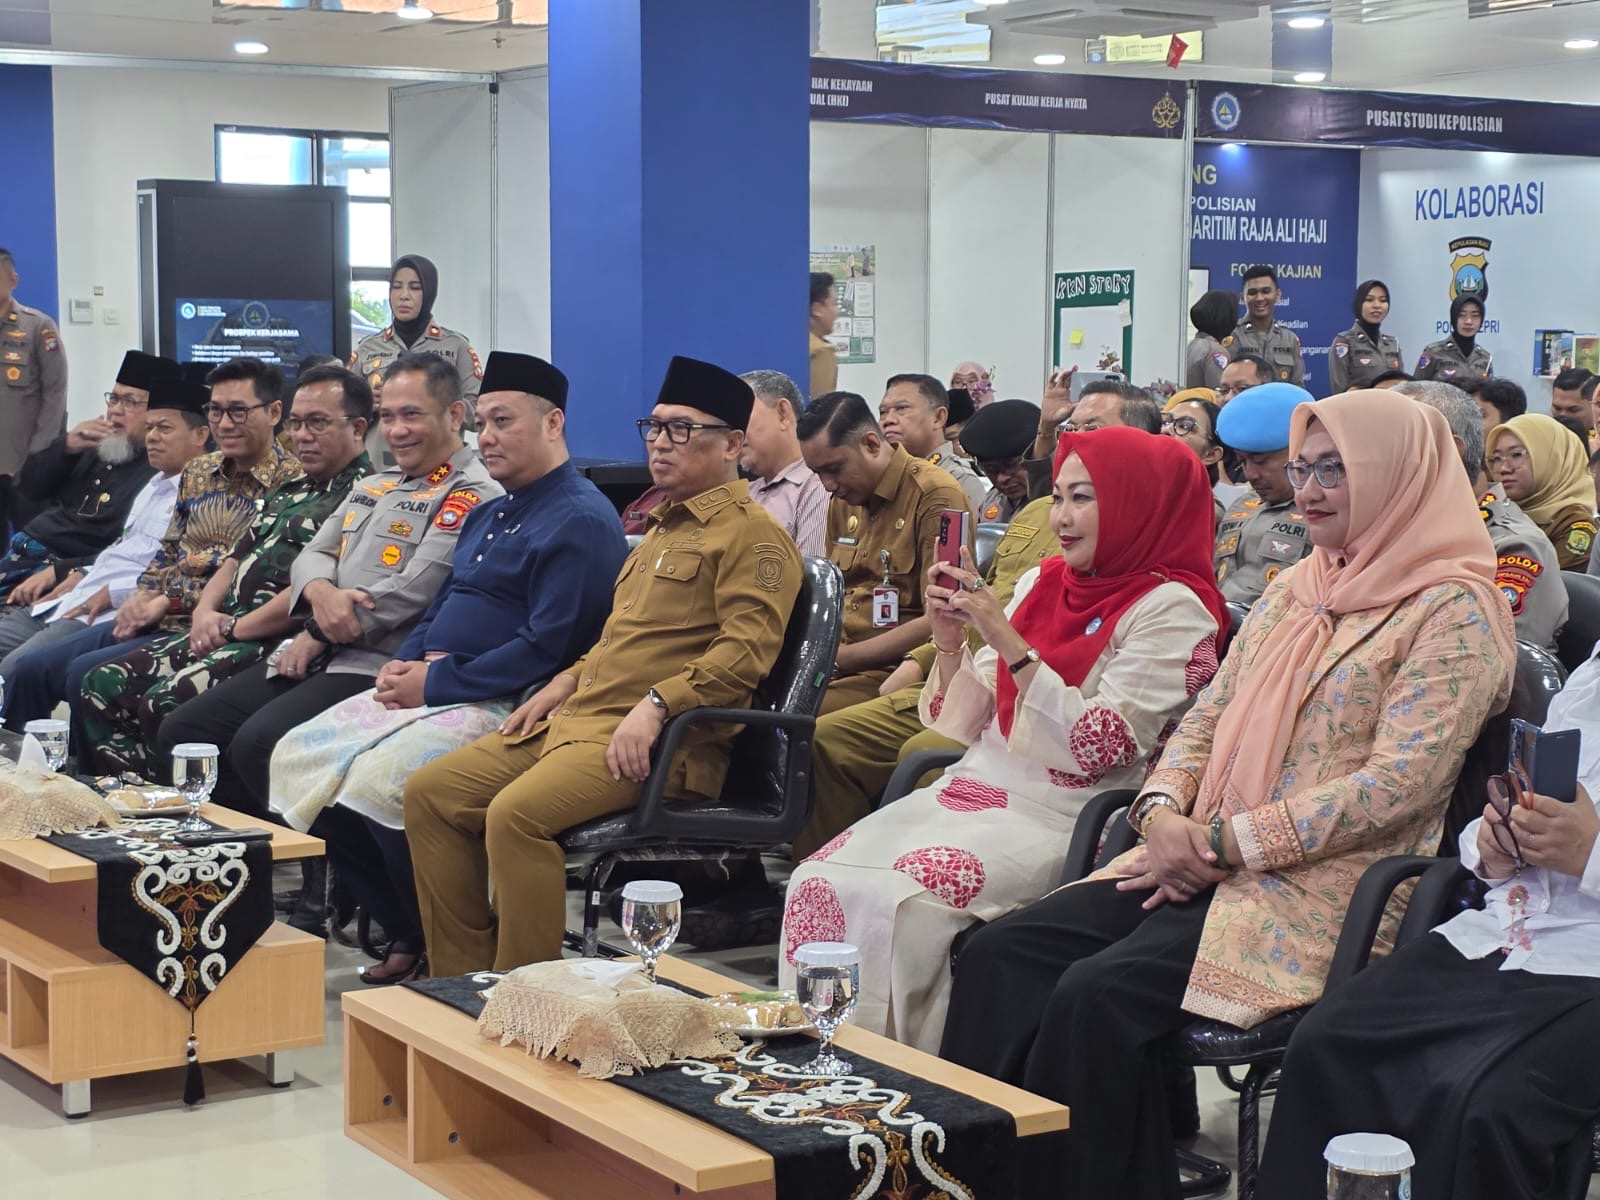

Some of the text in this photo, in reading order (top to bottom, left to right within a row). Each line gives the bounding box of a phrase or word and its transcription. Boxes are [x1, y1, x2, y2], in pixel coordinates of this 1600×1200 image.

[811, 76, 873, 92] HAK KEKAYAAN
[985, 92, 1087, 110] PUSAT KULIAH KERJA NYATA
[1366, 109, 1503, 132] PUSAT STUDI KEPOLISIAN
[1416, 181, 1544, 220] KOLABORASI
[1240, 216, 1274, 242] RAJA
[1275, 216, 1296, 243] ALI
[1299, 217, 1327, 244] HAJI
[1277, 263, 1322, 279] KAJIAN
[1056, 273, 1131, 299] KKN STORY
[393, 501, 429, 514] POLRI
[1271, 522, 1306, 538] POLRI
[1498, 556, 1540, 574] POLDA
